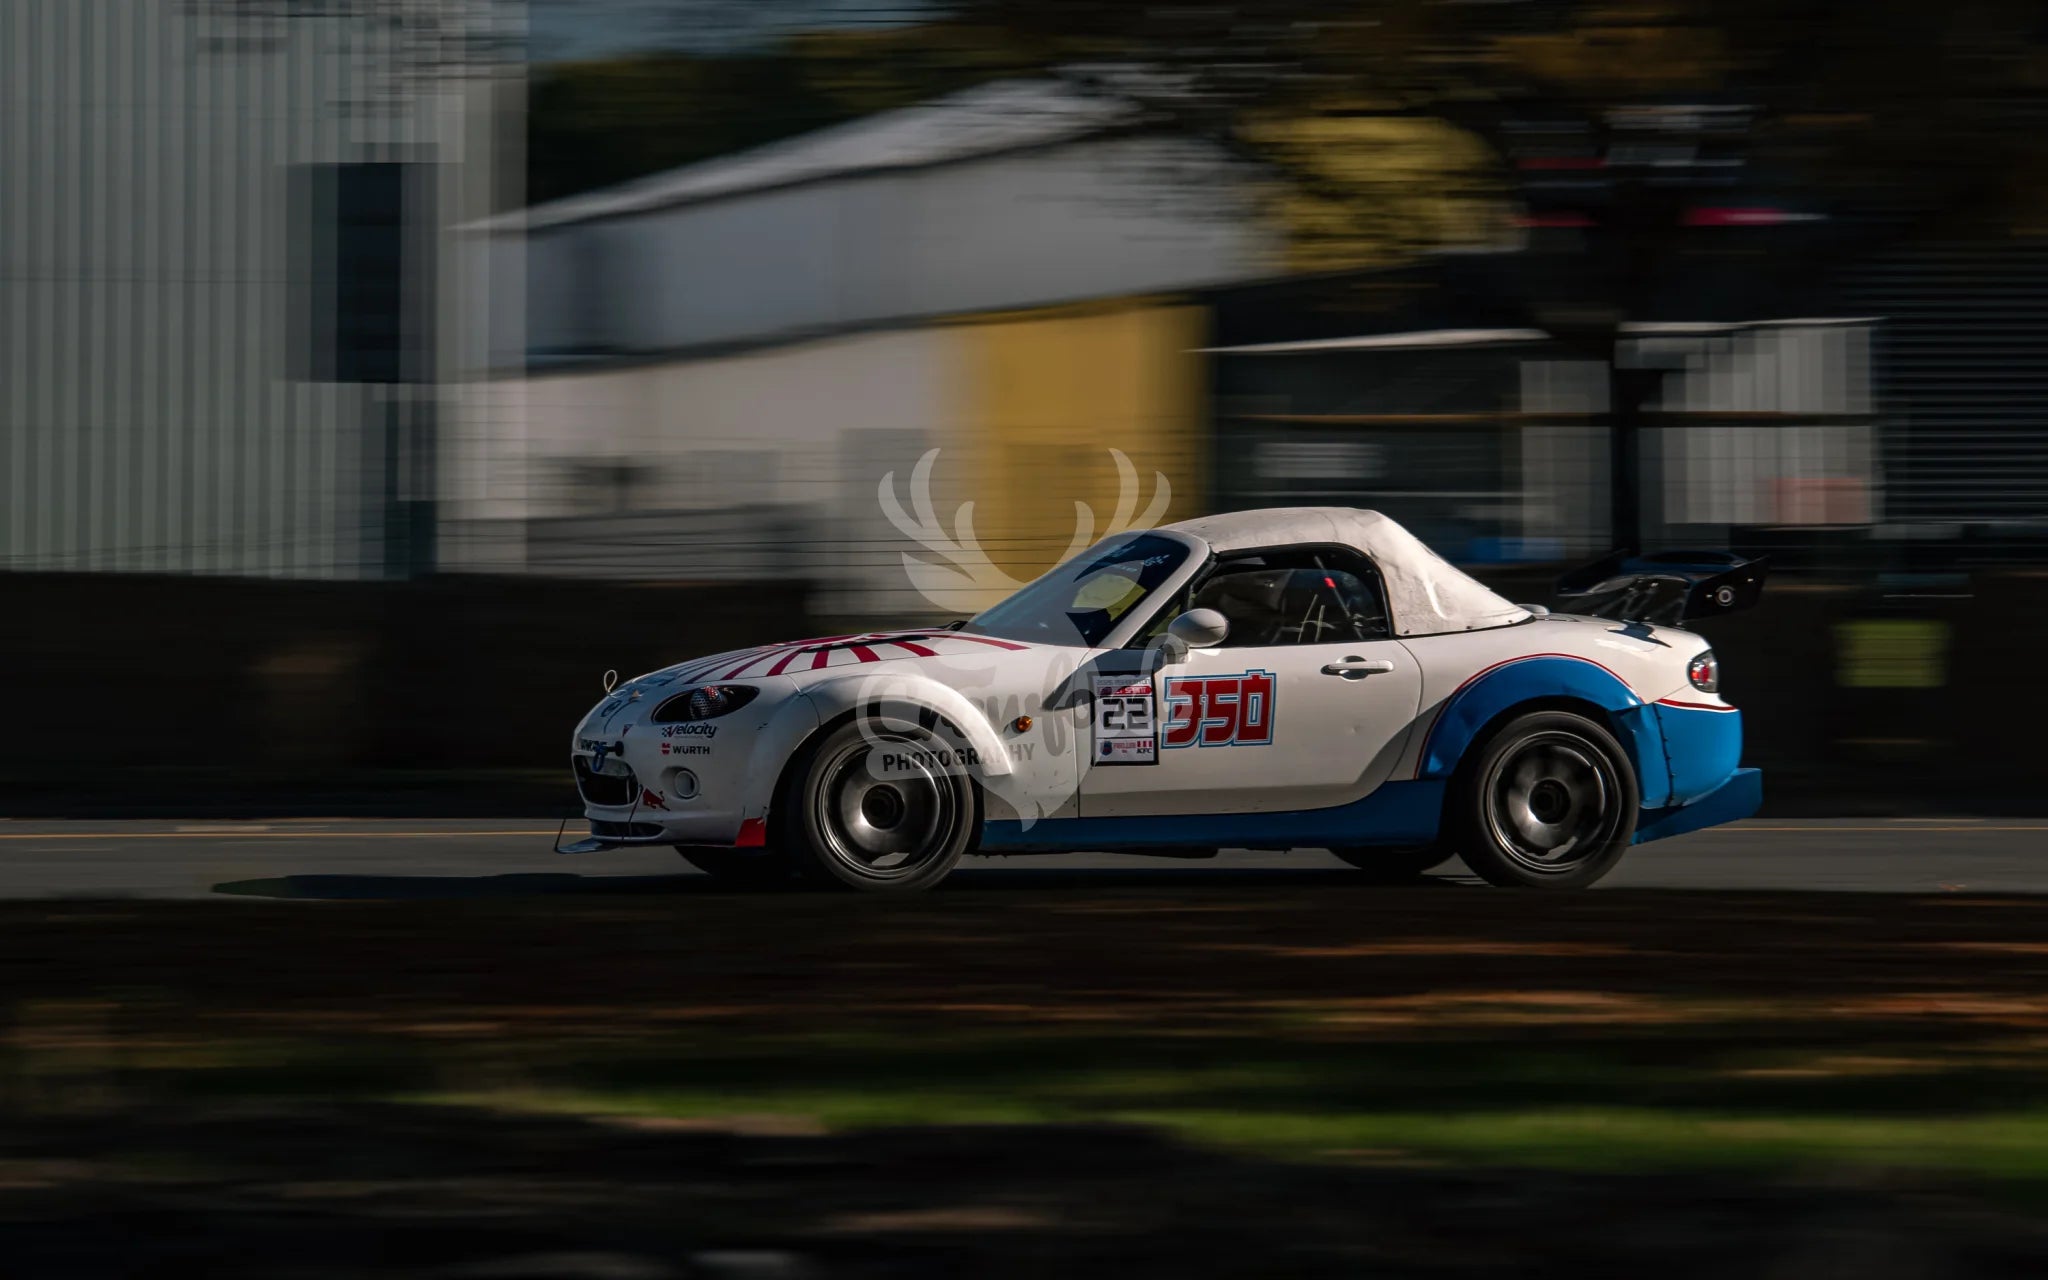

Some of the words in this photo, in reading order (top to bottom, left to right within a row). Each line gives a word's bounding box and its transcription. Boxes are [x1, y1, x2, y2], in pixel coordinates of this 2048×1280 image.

[1103, 698, 1149, 730] 22
[1160, 669, 1277, 749] 350
[667, 722, 718, 738] Velocity
